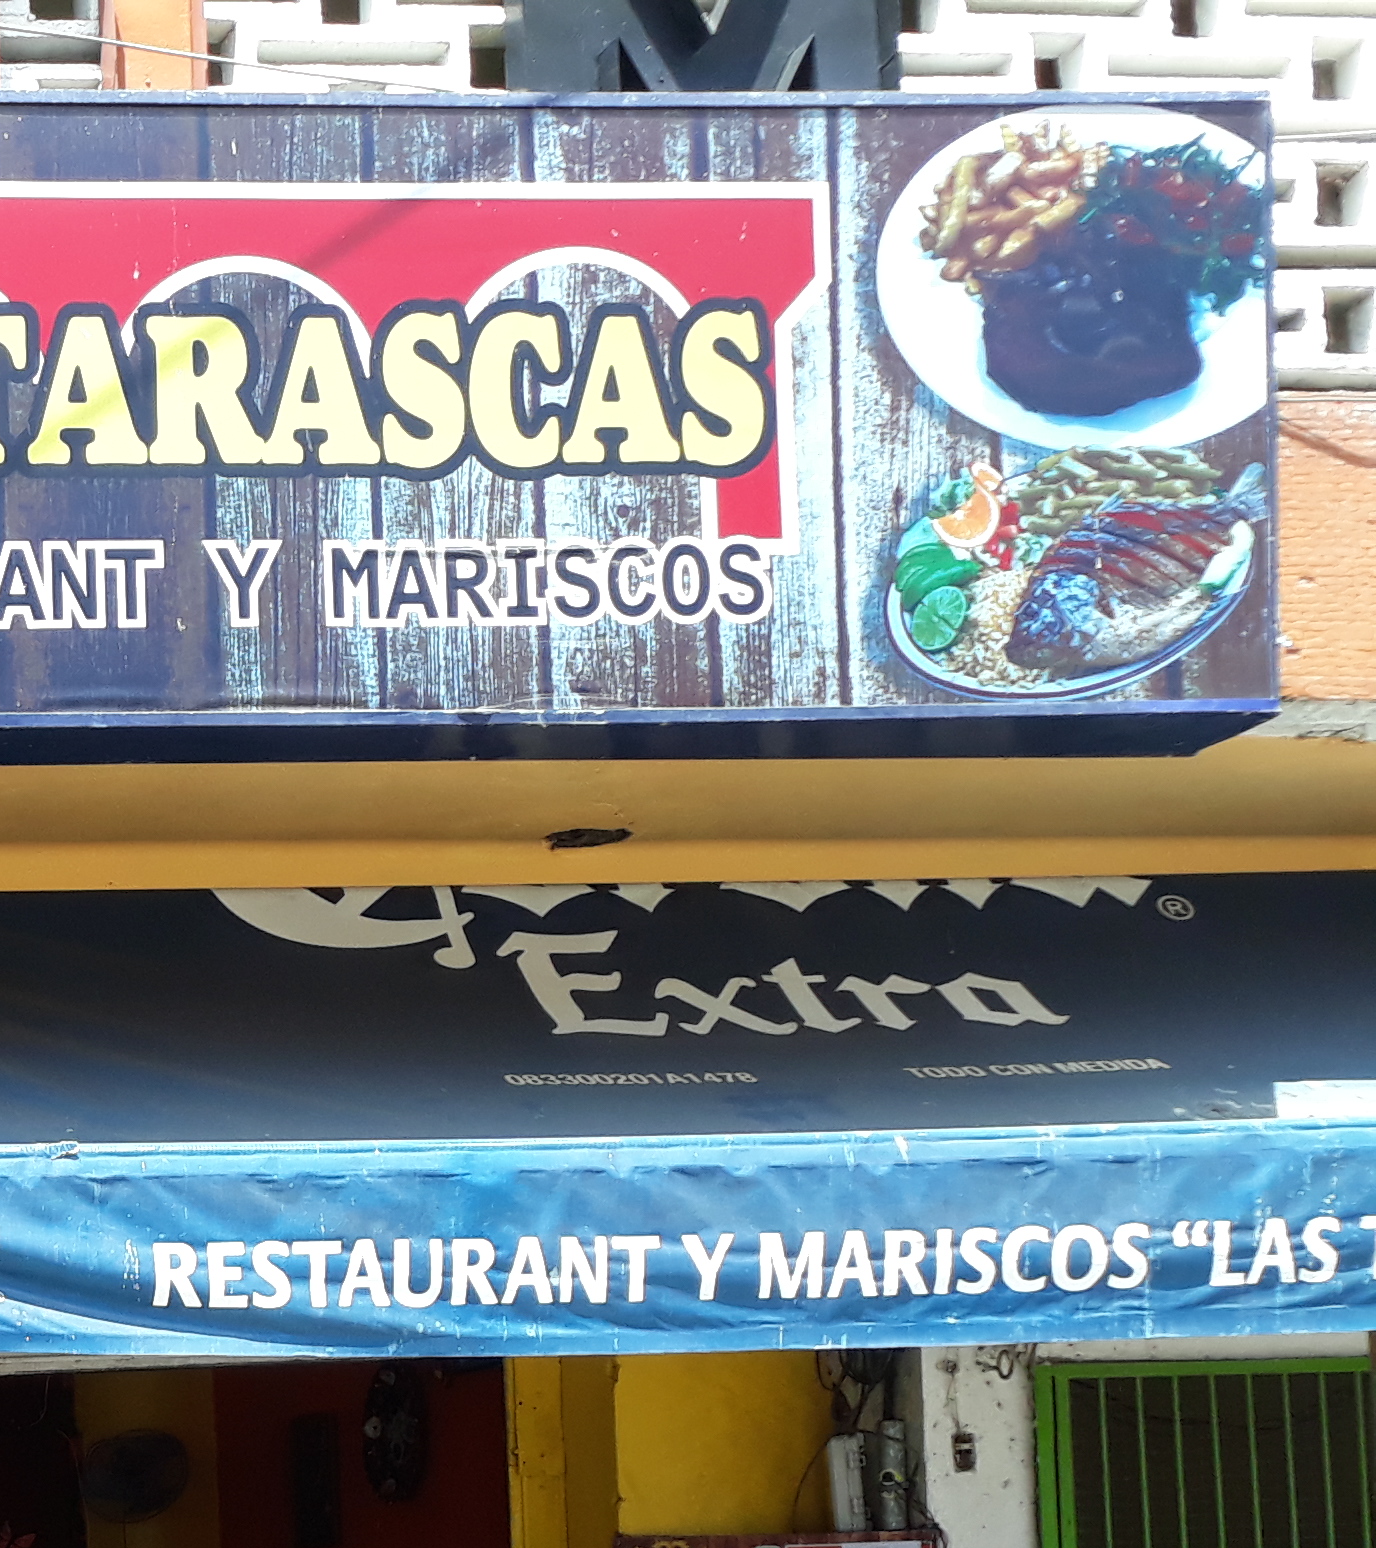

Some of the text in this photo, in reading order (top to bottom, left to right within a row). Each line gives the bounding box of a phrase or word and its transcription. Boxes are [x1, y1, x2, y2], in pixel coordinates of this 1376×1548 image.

[208, 539, 282, 628] Y
[324, 540, 773, 628] MARISCOS
[495, 929, 1071, 1037] Extra
[503, 1072, 759, 1086] 083300201A1478
[903, 1058, 1172, 1079] TODO CON MEDIDA
[152, 1234, 661, 1309] RESTAURANT
[680, 1233, 735, 1302] Y
[758, 1223, 1152, 1299] MARISCOS
